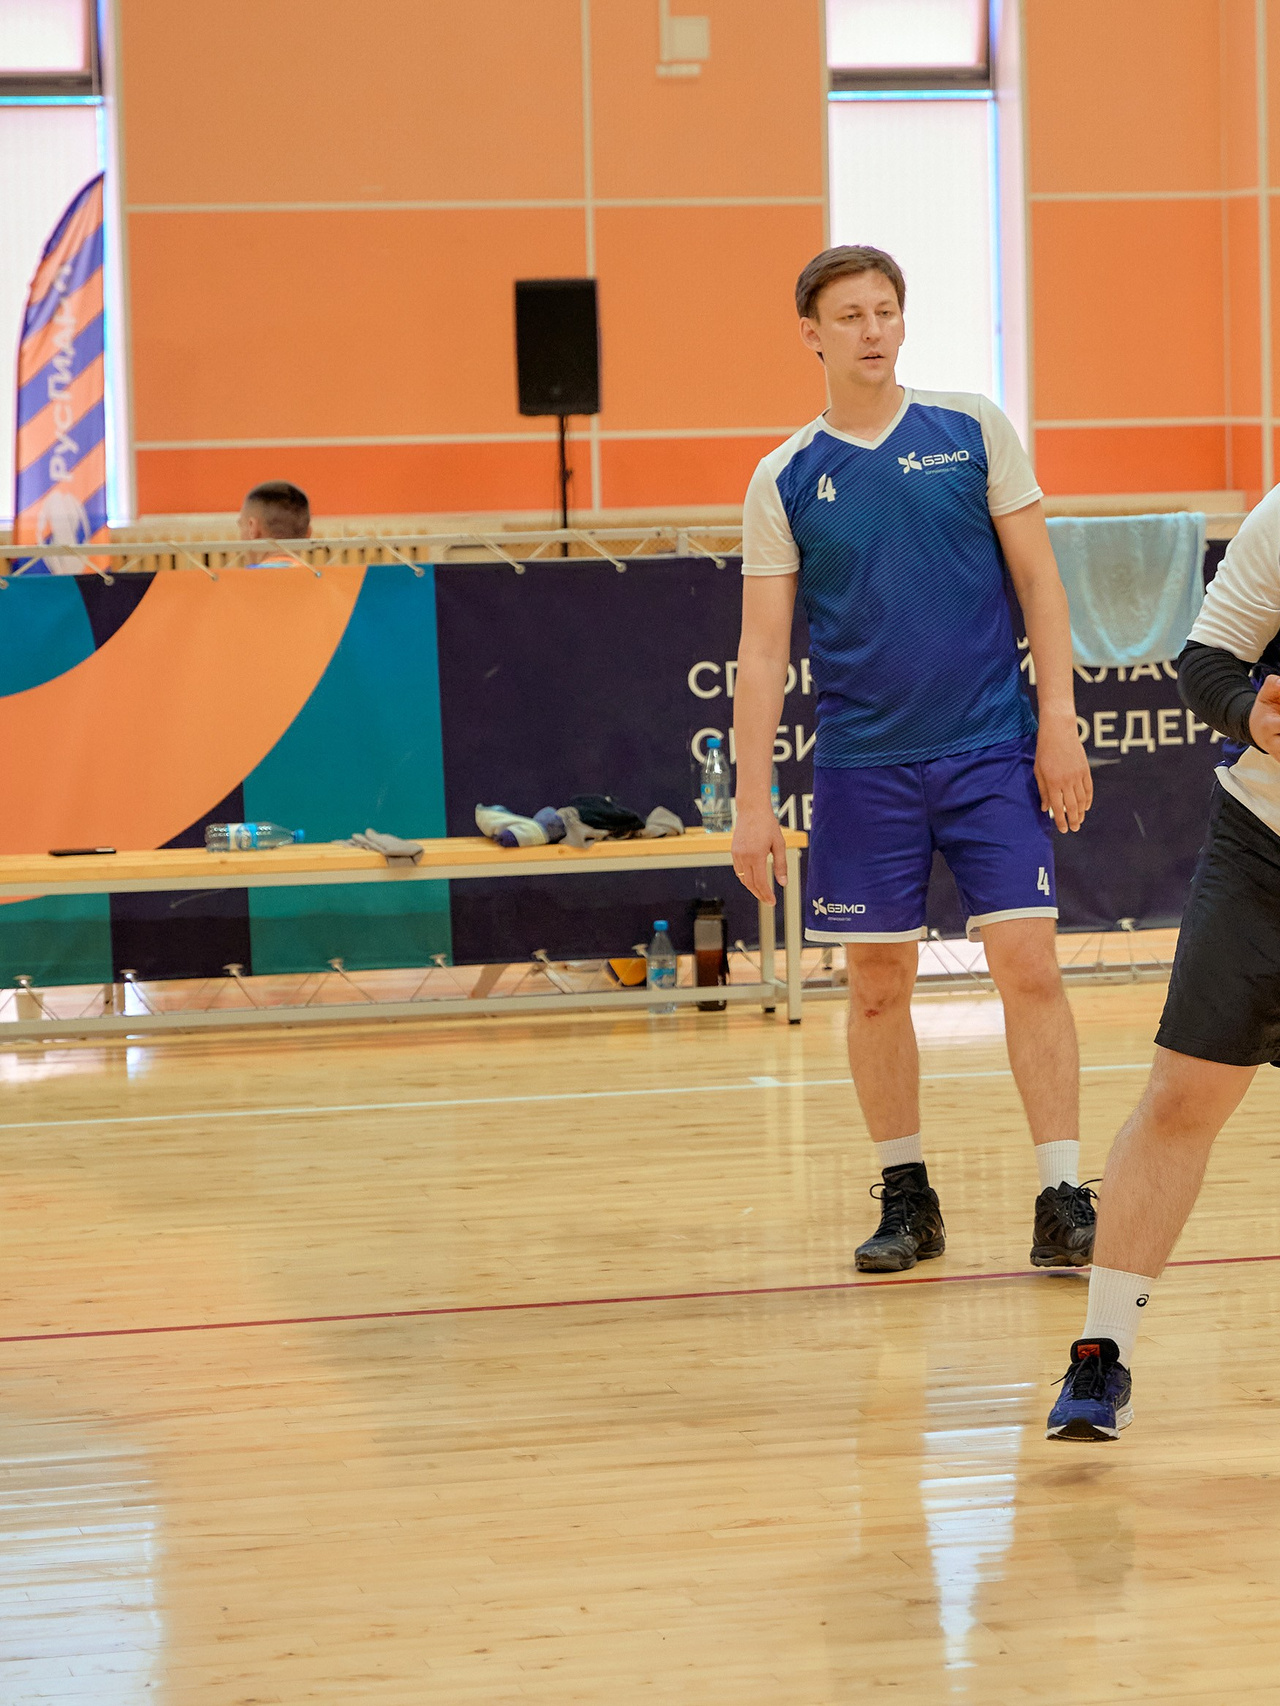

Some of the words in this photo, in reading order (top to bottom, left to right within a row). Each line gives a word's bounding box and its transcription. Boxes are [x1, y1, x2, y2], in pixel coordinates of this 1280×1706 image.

[921, 450, 970, 467] БЭМО
[817, 472, 837, 502] 4
[1036, 866, 1051, 896] 4
[827, 903, 866, 914] БЭМО
